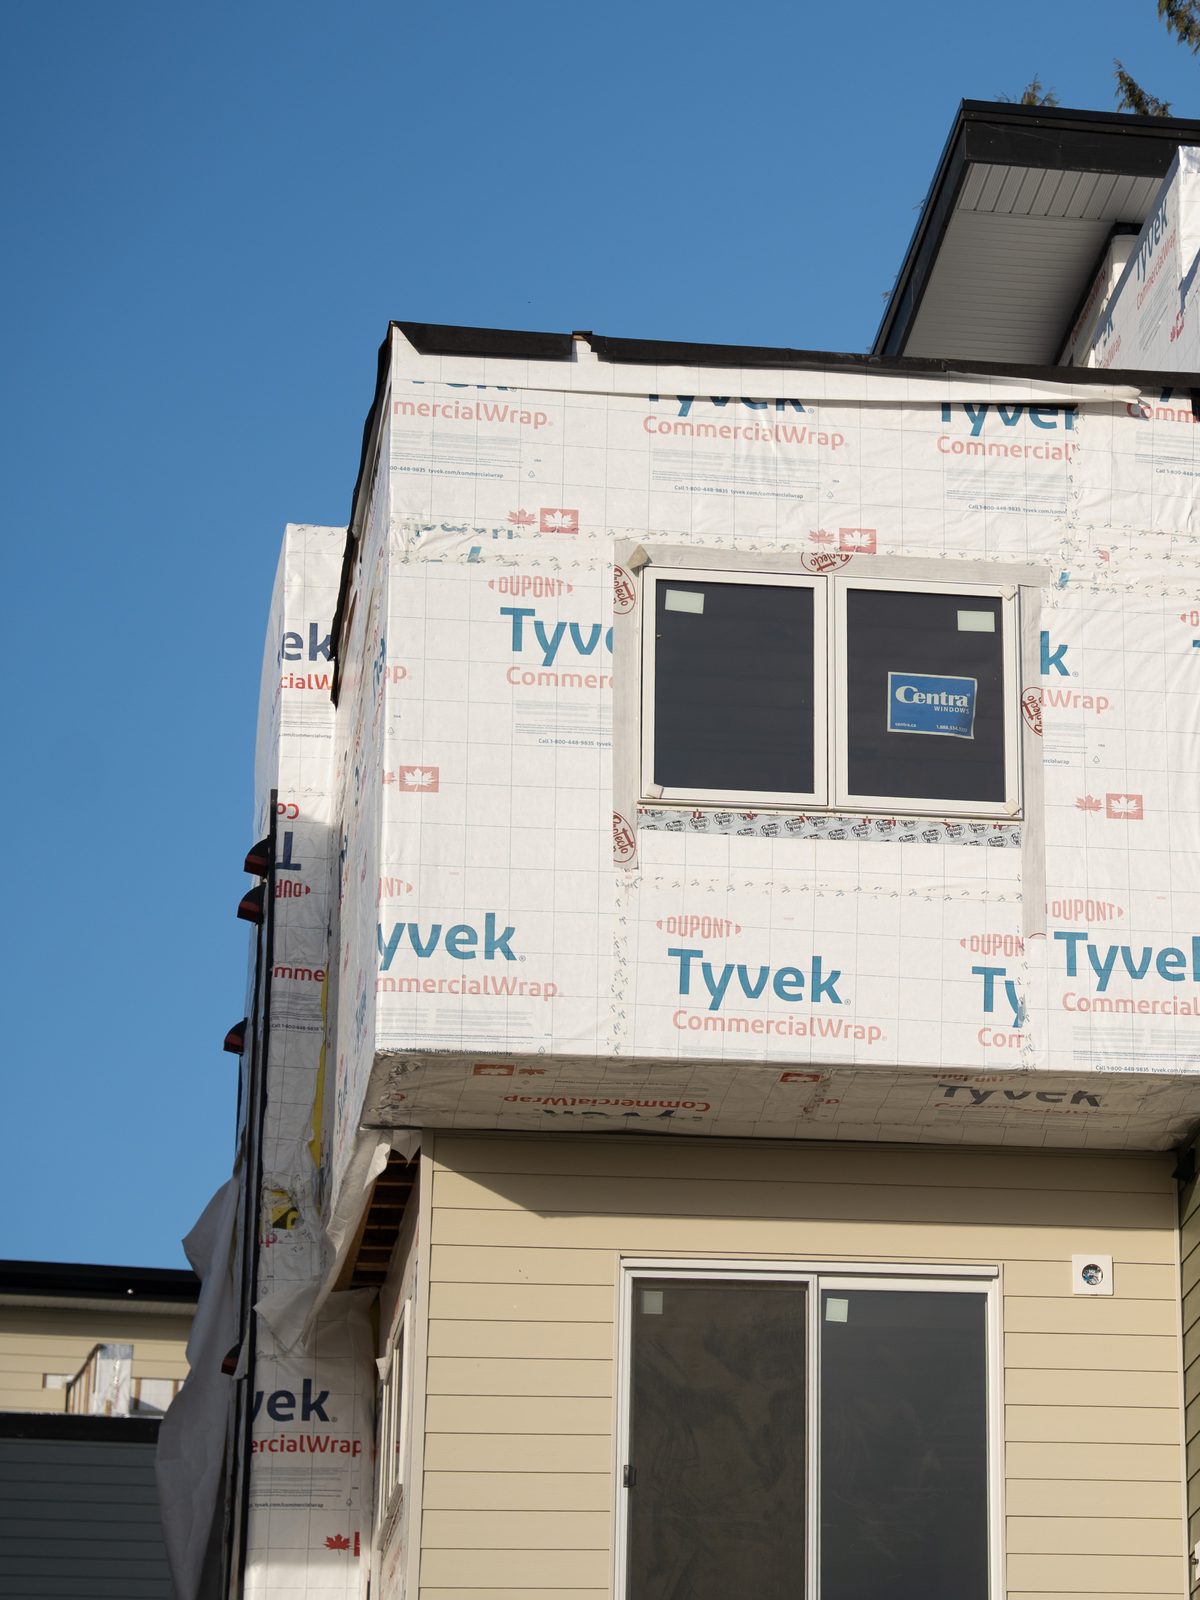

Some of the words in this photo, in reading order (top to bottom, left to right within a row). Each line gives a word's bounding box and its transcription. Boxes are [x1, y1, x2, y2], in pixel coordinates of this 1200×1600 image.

[643, 415, 845, 451] CommercialWrap
[936, 435, 1077, 461] Commercial
[499, 575, 564, 598] DUPONT
[895, 685, 969, 708] Centra
[934, 706, 970, 715] WINDOWS
[1052, 899, 1115, 922] DUPONT
[666, 915, 732, 939] DUPONT
[668, 948, 843, 1011] Tyvek
[672, 1010, 882, 1044] CommercialWrap
[938, 1083, 1104, 1108] Tyvek
